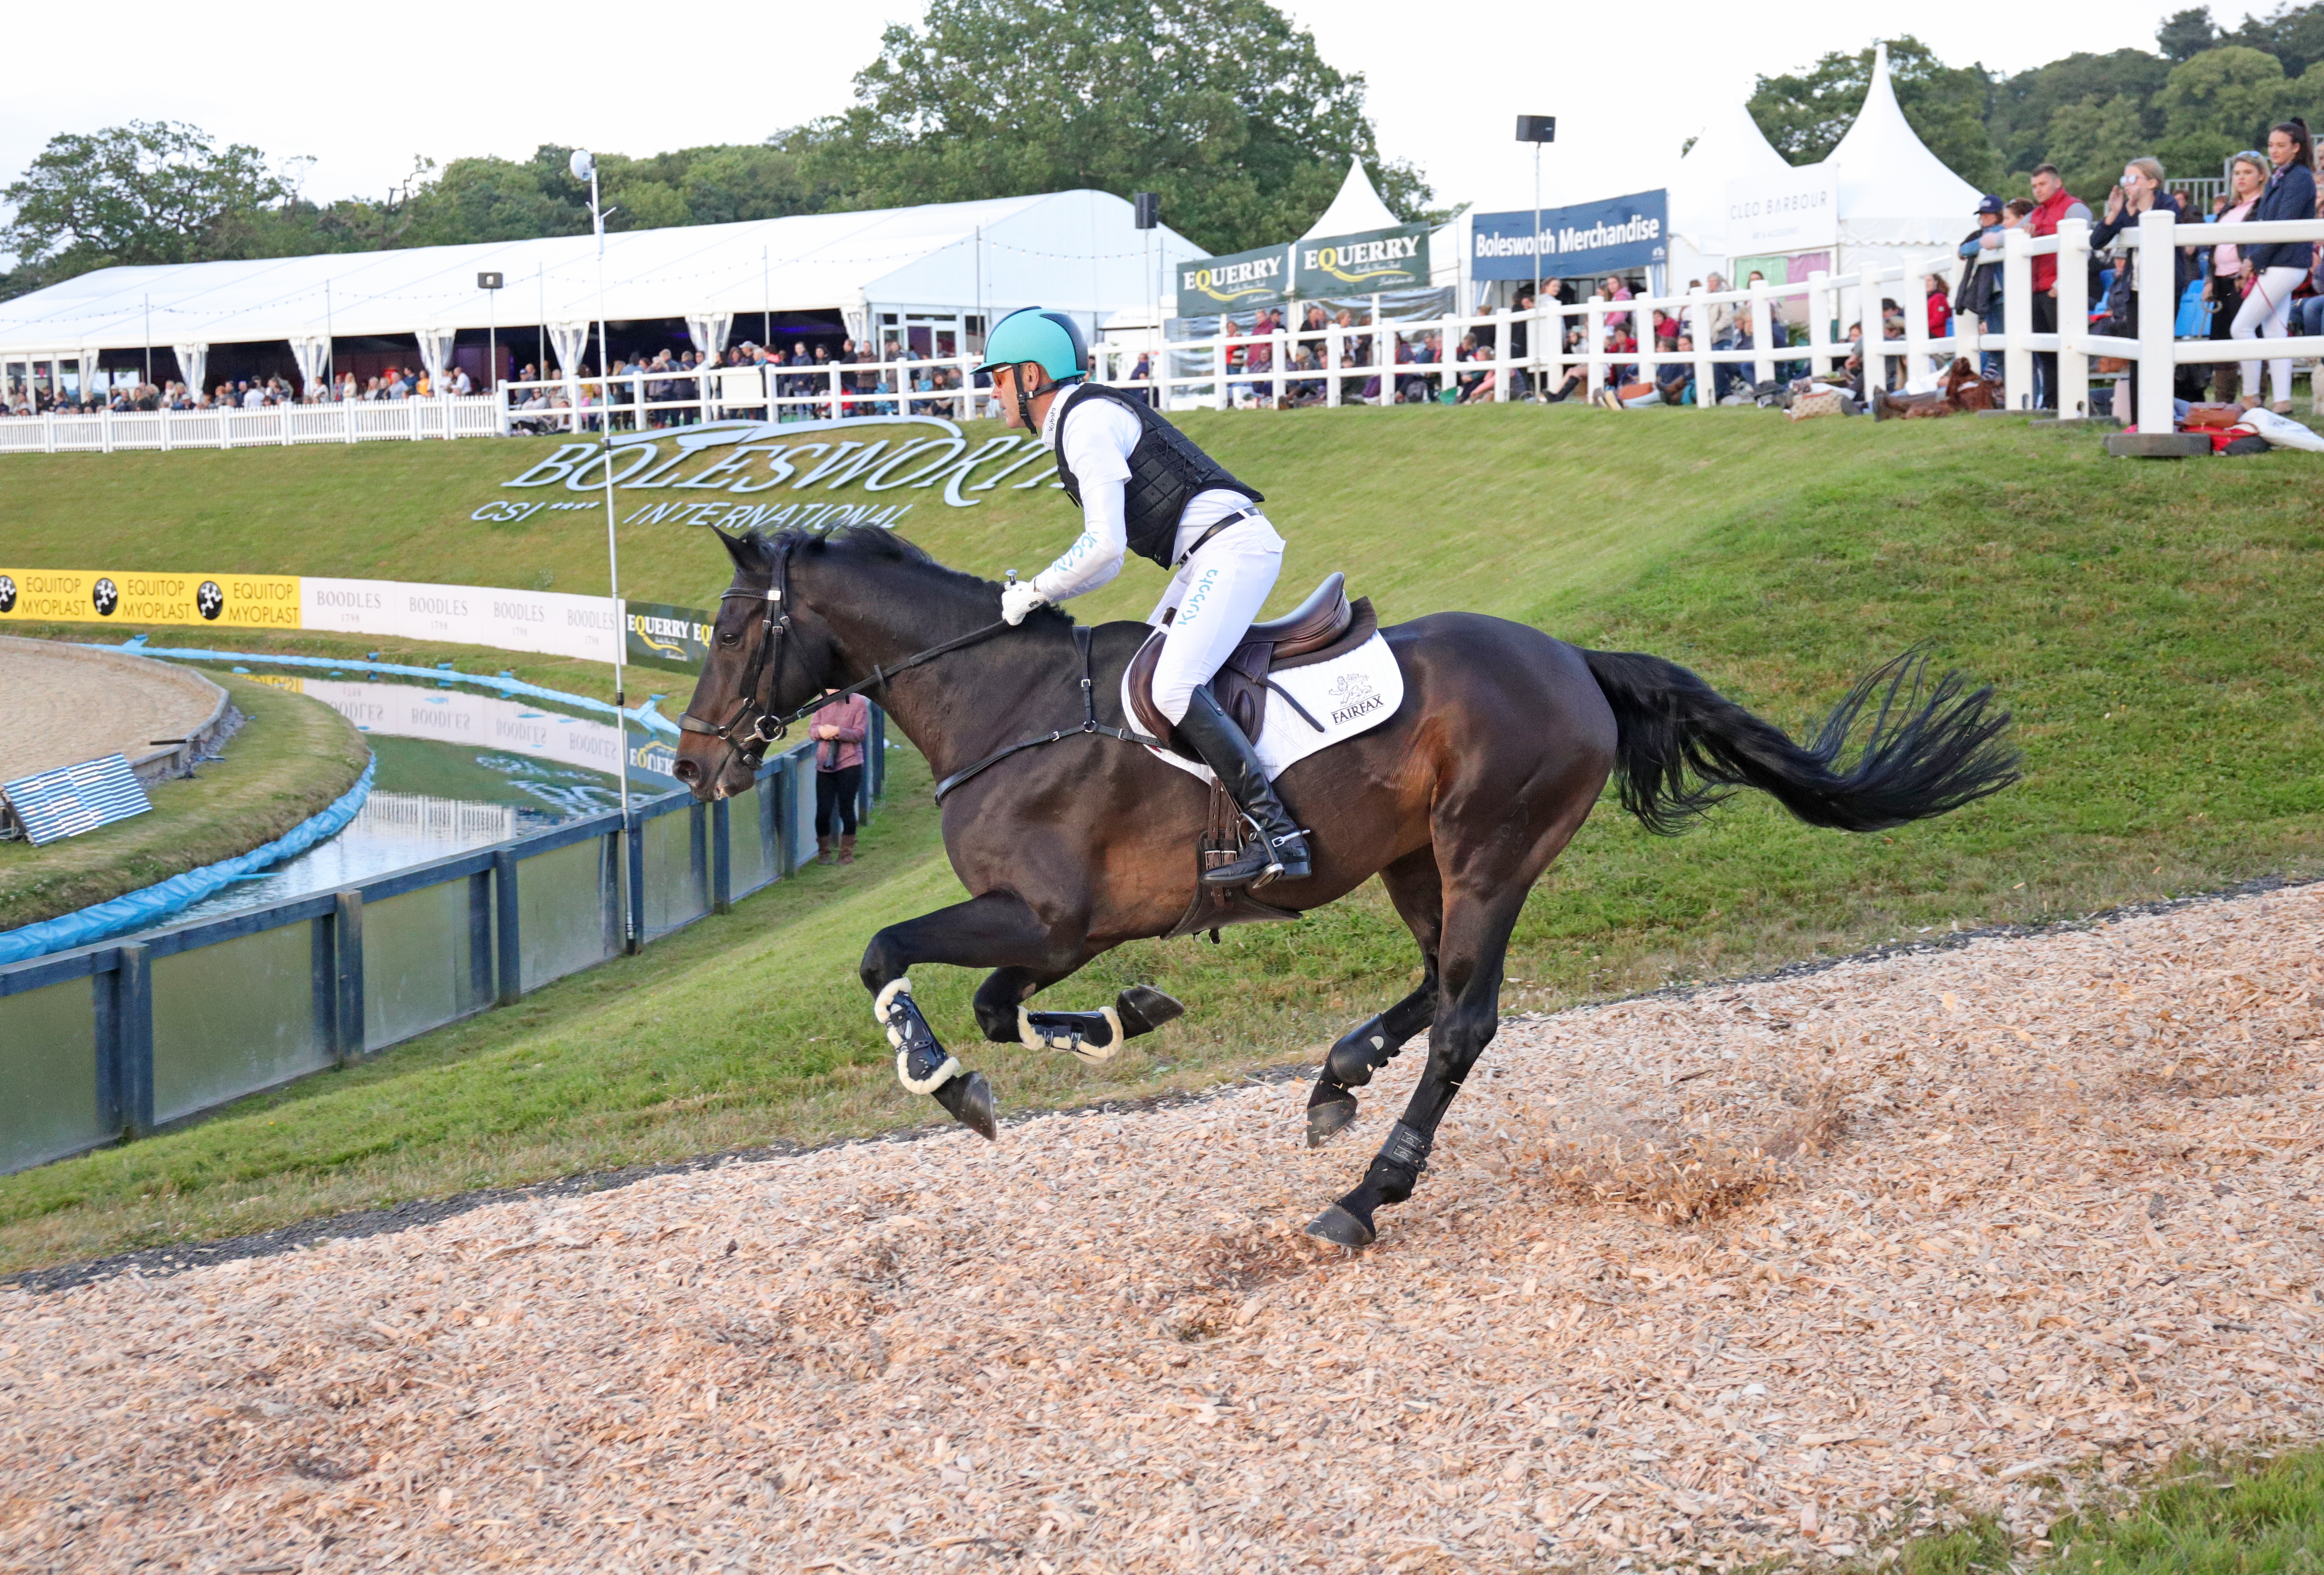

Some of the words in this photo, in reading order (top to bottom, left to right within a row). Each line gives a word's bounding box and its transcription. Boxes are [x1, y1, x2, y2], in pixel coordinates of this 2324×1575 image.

[1730, 201, 1760, 220] CLEO
[1766, 191, 1827, 215] BARBOUR
[1476, 228, 1556, 258] Bolesworth
[1559, 214, 1660, 253] Merchandise
[1304, 235, 1421, 271] EQUERRY
[1183, 255, 1282, 291] EQUERRY
[501, 433, 1065, 507] BOLESWORT
[471, 500, 547, 522] CSI
[622, 501, 914, 530] INTERNATIONAL
[26, 577, 81, 593] EQUITOP
[127, 579, 185, 596] EQUITOP
[233, 582, 293, 600] EQUITOP
[21, 599, 86, 616] MYOPLAST
[316, 590, 381, 609] BOODLES
[409, 596, 468, 617] BOODLES
[1177, 569, 1219, 625] Kubota
[122, 601, 191, 619] MYOPLAST
[228, 606, 298, 624] MYOPLAST
[493, 601, 545, 622] BOODLES
[567, 609, 615, 631] BOODLES
[627, 614, 690, 639] EQUERRY
[1332, 695, 1384, 724] FAIRFAX
